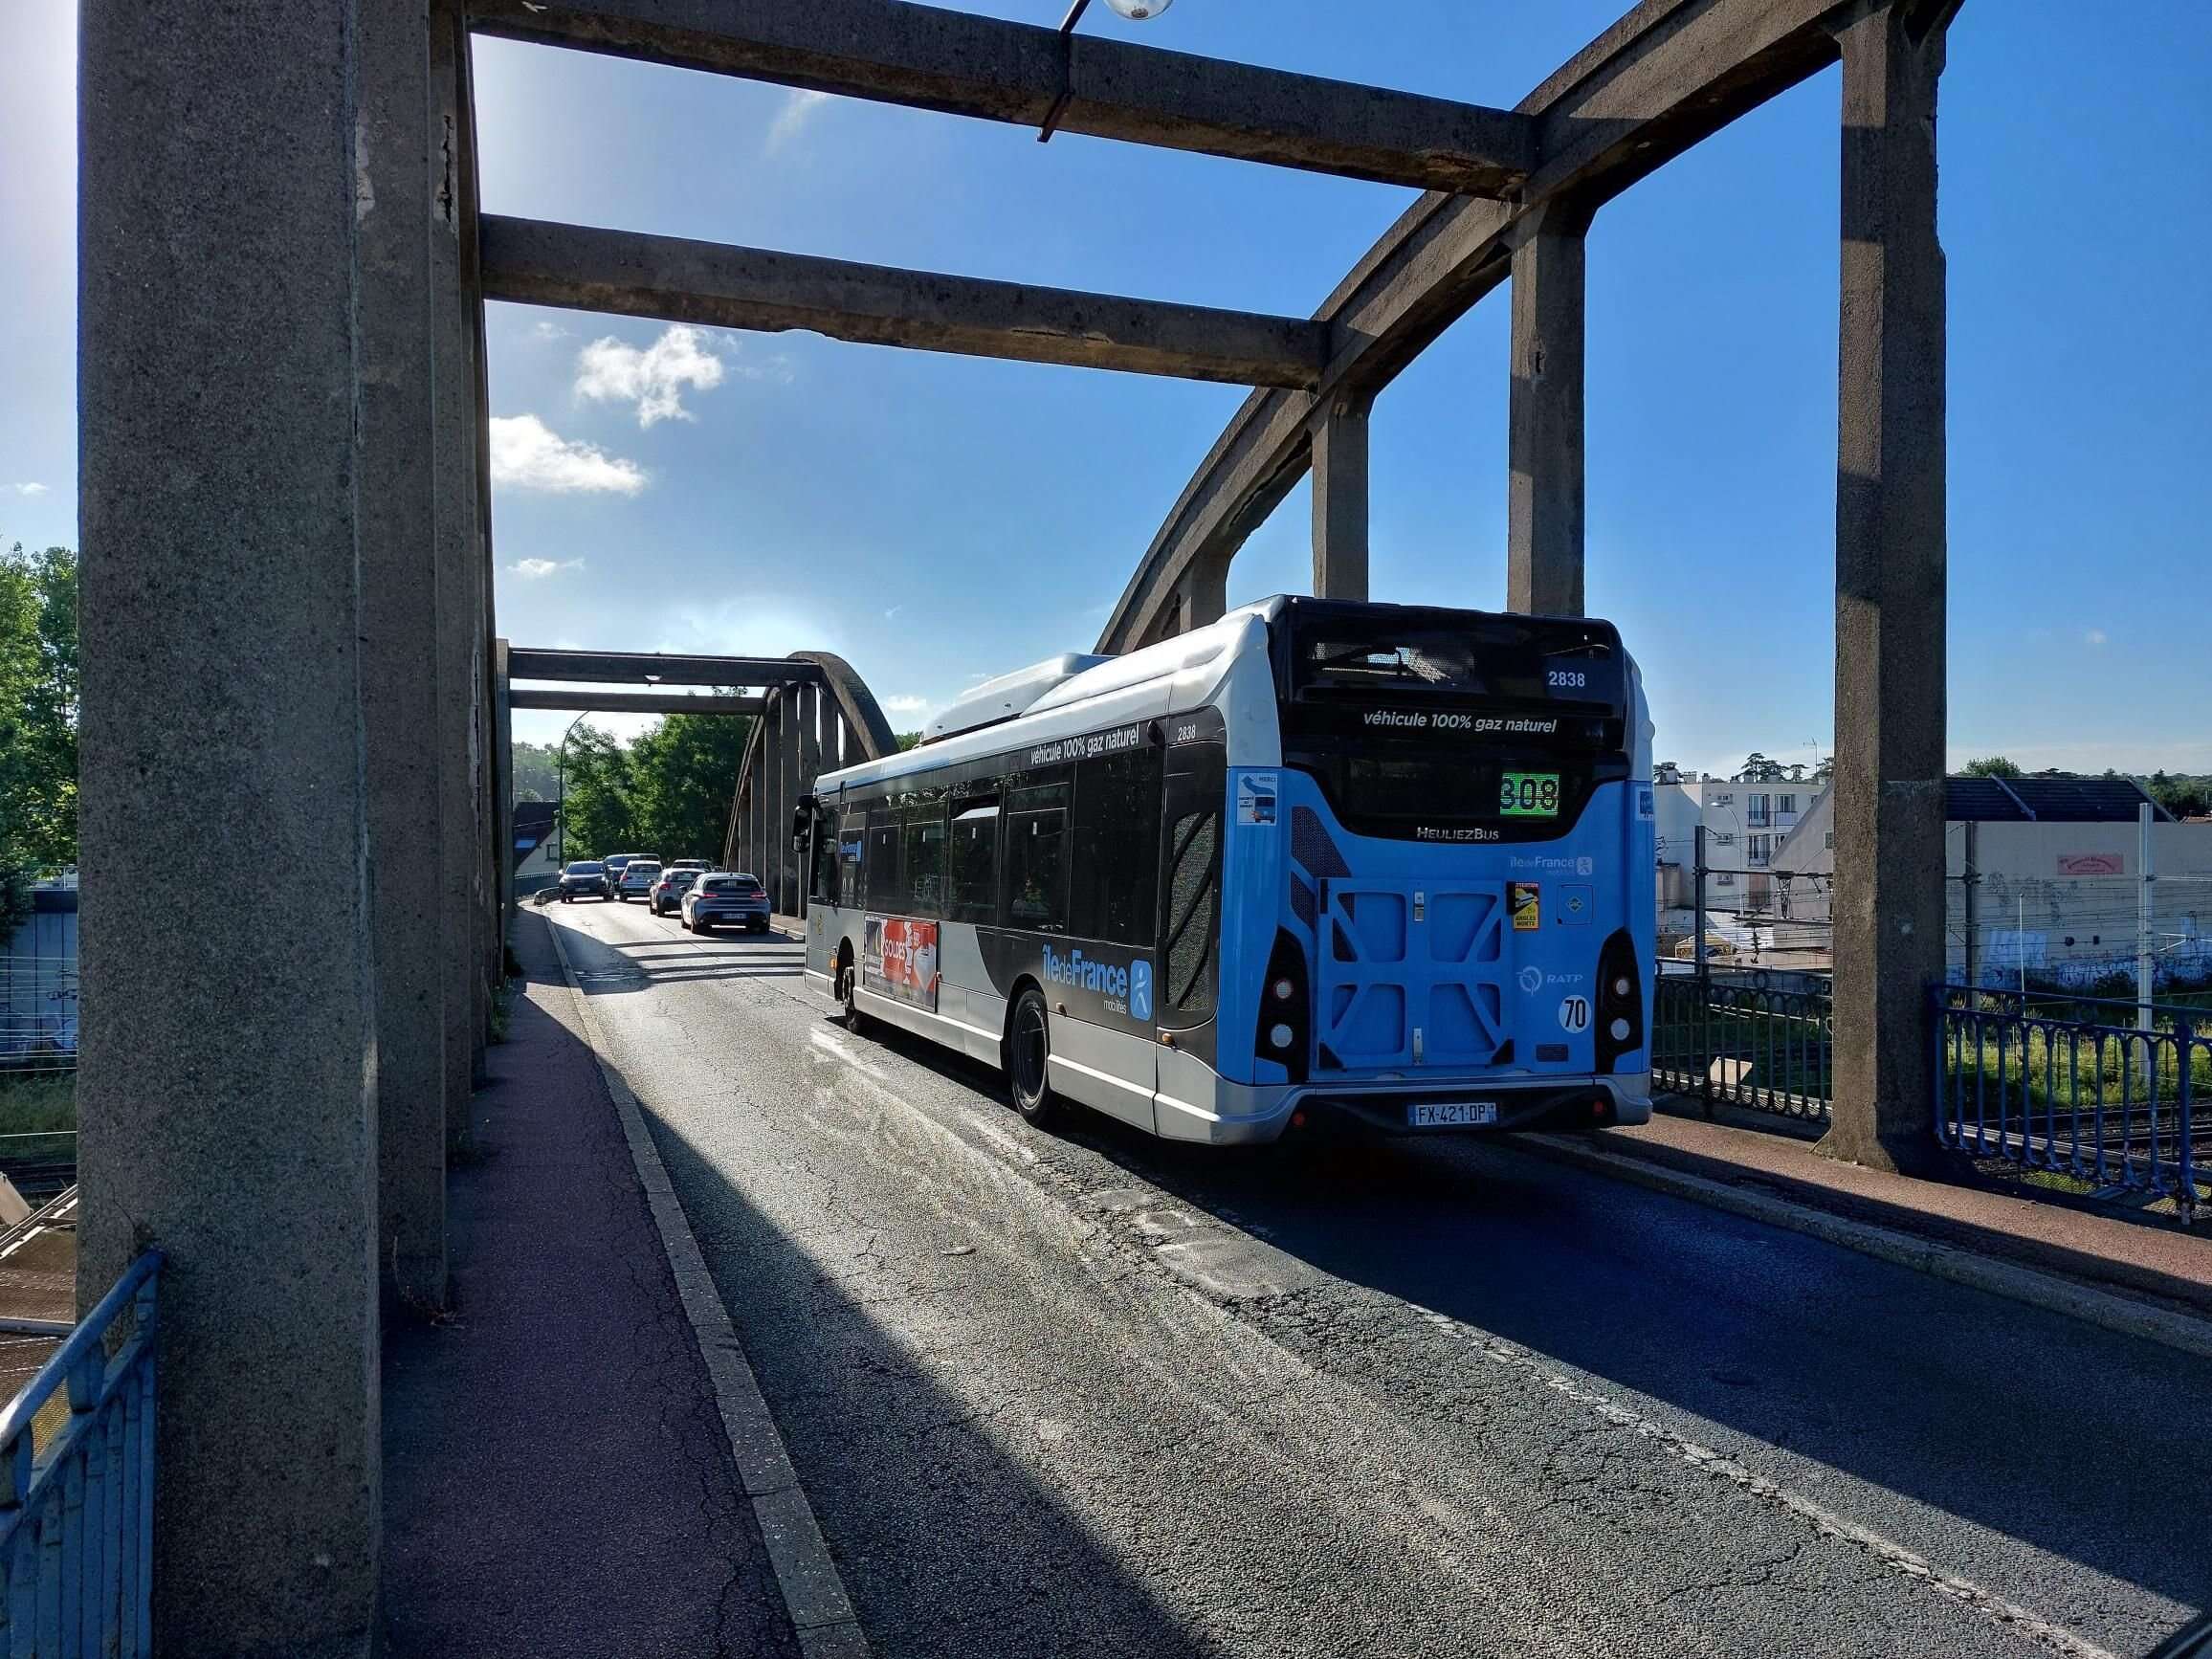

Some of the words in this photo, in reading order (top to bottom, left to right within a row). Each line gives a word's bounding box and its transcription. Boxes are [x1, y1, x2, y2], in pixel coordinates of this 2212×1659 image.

[1548, 671, 1585, 687] 2838
[1363, 710, 1427, 727] véhicule
[1432, 714, 1471, 729] 100%
[1475, 719, 1502, 731] gaz
[1505, 719, 1558, 733] naturel
[1030, 742, 1062, 764] véhicule
[1063, 736, 1086, 759] 100%
[1087, 734, 1103, 758] gaz
[1105, 722, 1139, 750] naturel
[1178, 724, 1196, 742] 2838
[1500, 777, 1558, 810] 308
[884, 939, 906, 961] SOLDES
[1546, 974, 1583, 984] RATP
[1564, 999, 1586, 1028] 70
